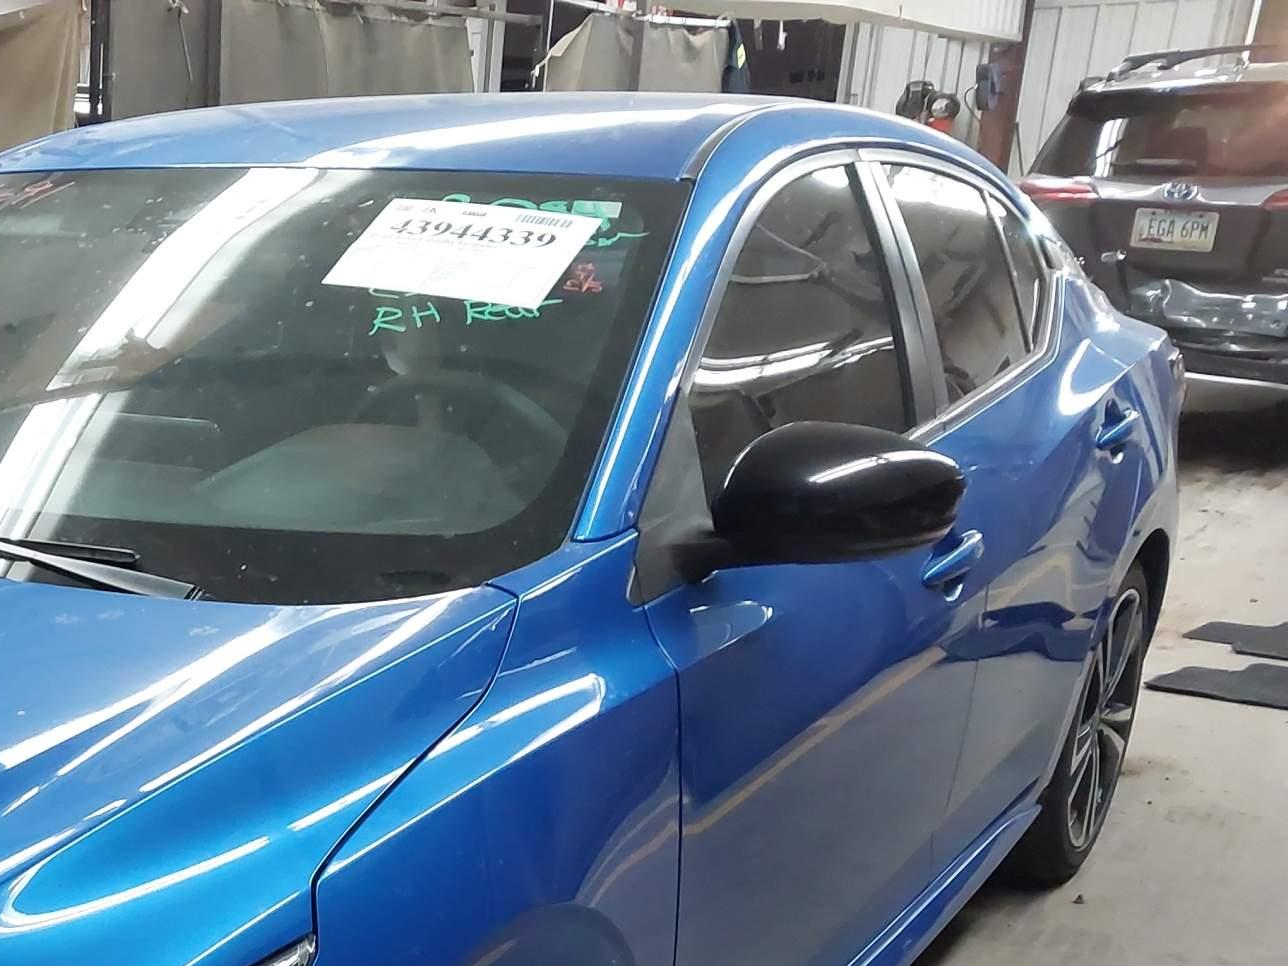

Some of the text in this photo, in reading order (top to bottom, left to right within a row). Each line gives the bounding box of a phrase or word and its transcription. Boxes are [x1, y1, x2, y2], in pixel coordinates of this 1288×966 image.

[389, 217, 558, 249] 43944339
[1147, 216, 1175, 239] EGA
[368, 301, 441, 336] RH
